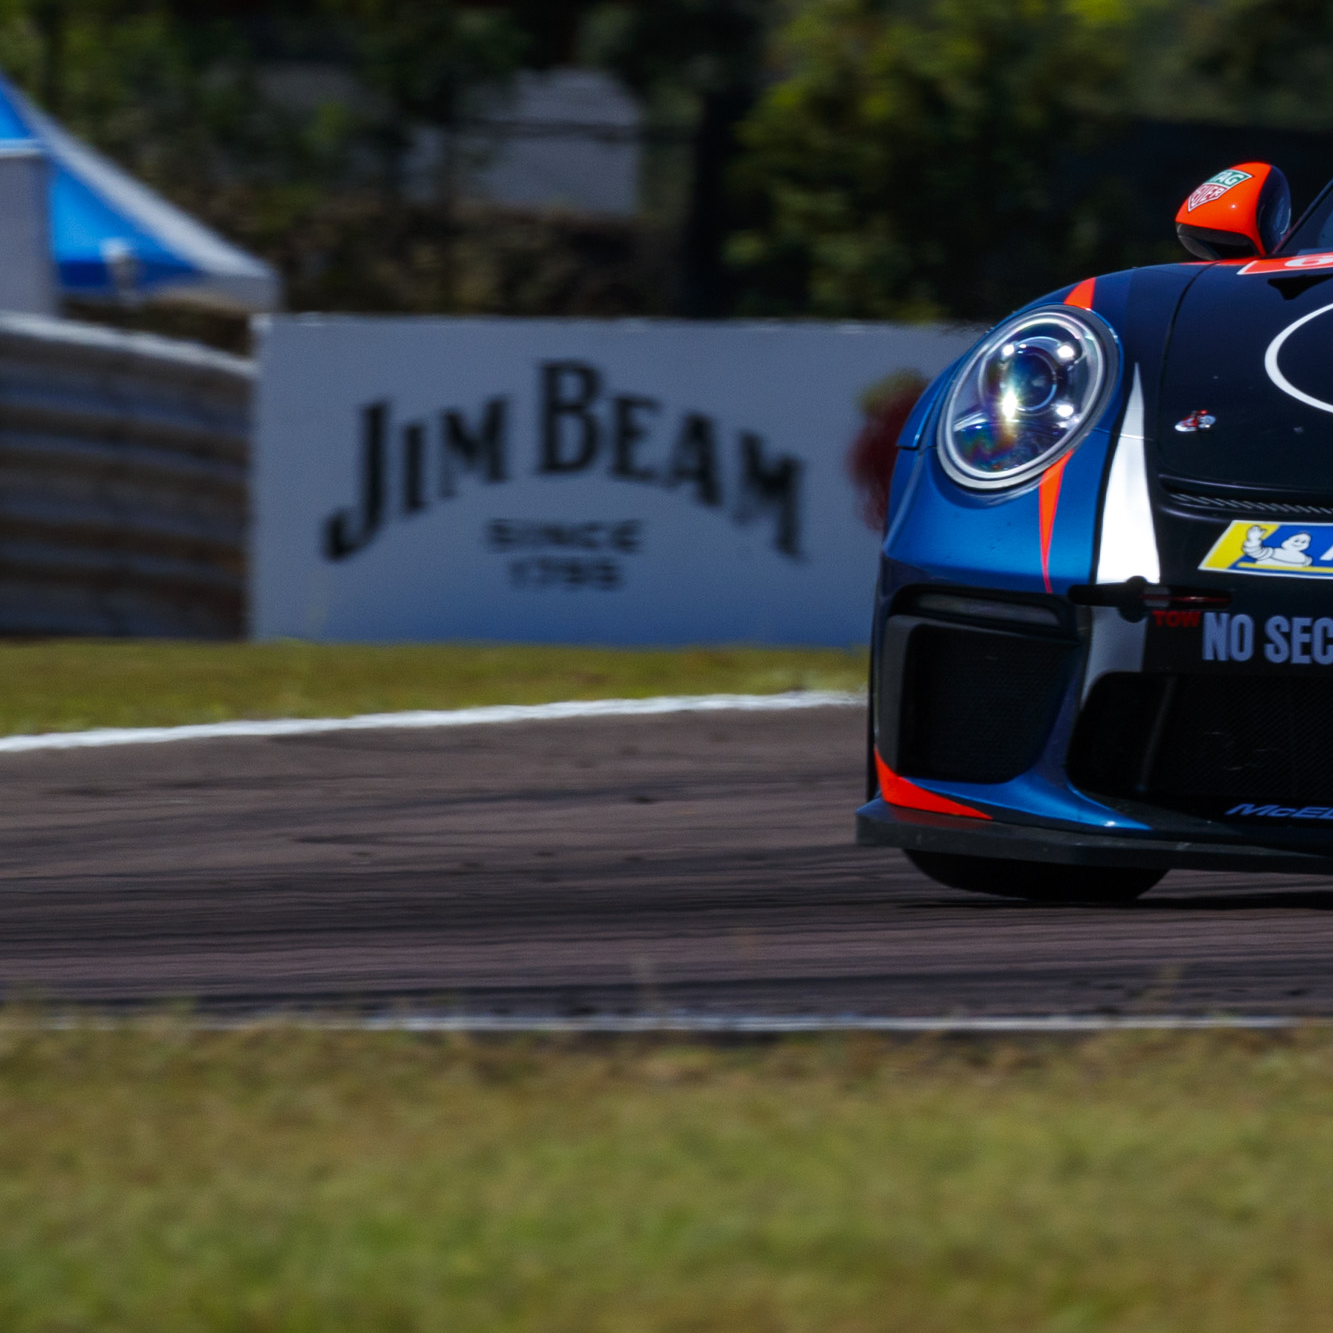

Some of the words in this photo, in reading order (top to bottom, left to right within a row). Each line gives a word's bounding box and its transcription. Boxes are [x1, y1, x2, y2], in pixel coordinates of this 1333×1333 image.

[322, 394, 510, 562] JIM
[536, 359, 807, 559] BEAM
[1152, 610, 1200, 627] TOW
[1204, 611, 1255, 662] NO
